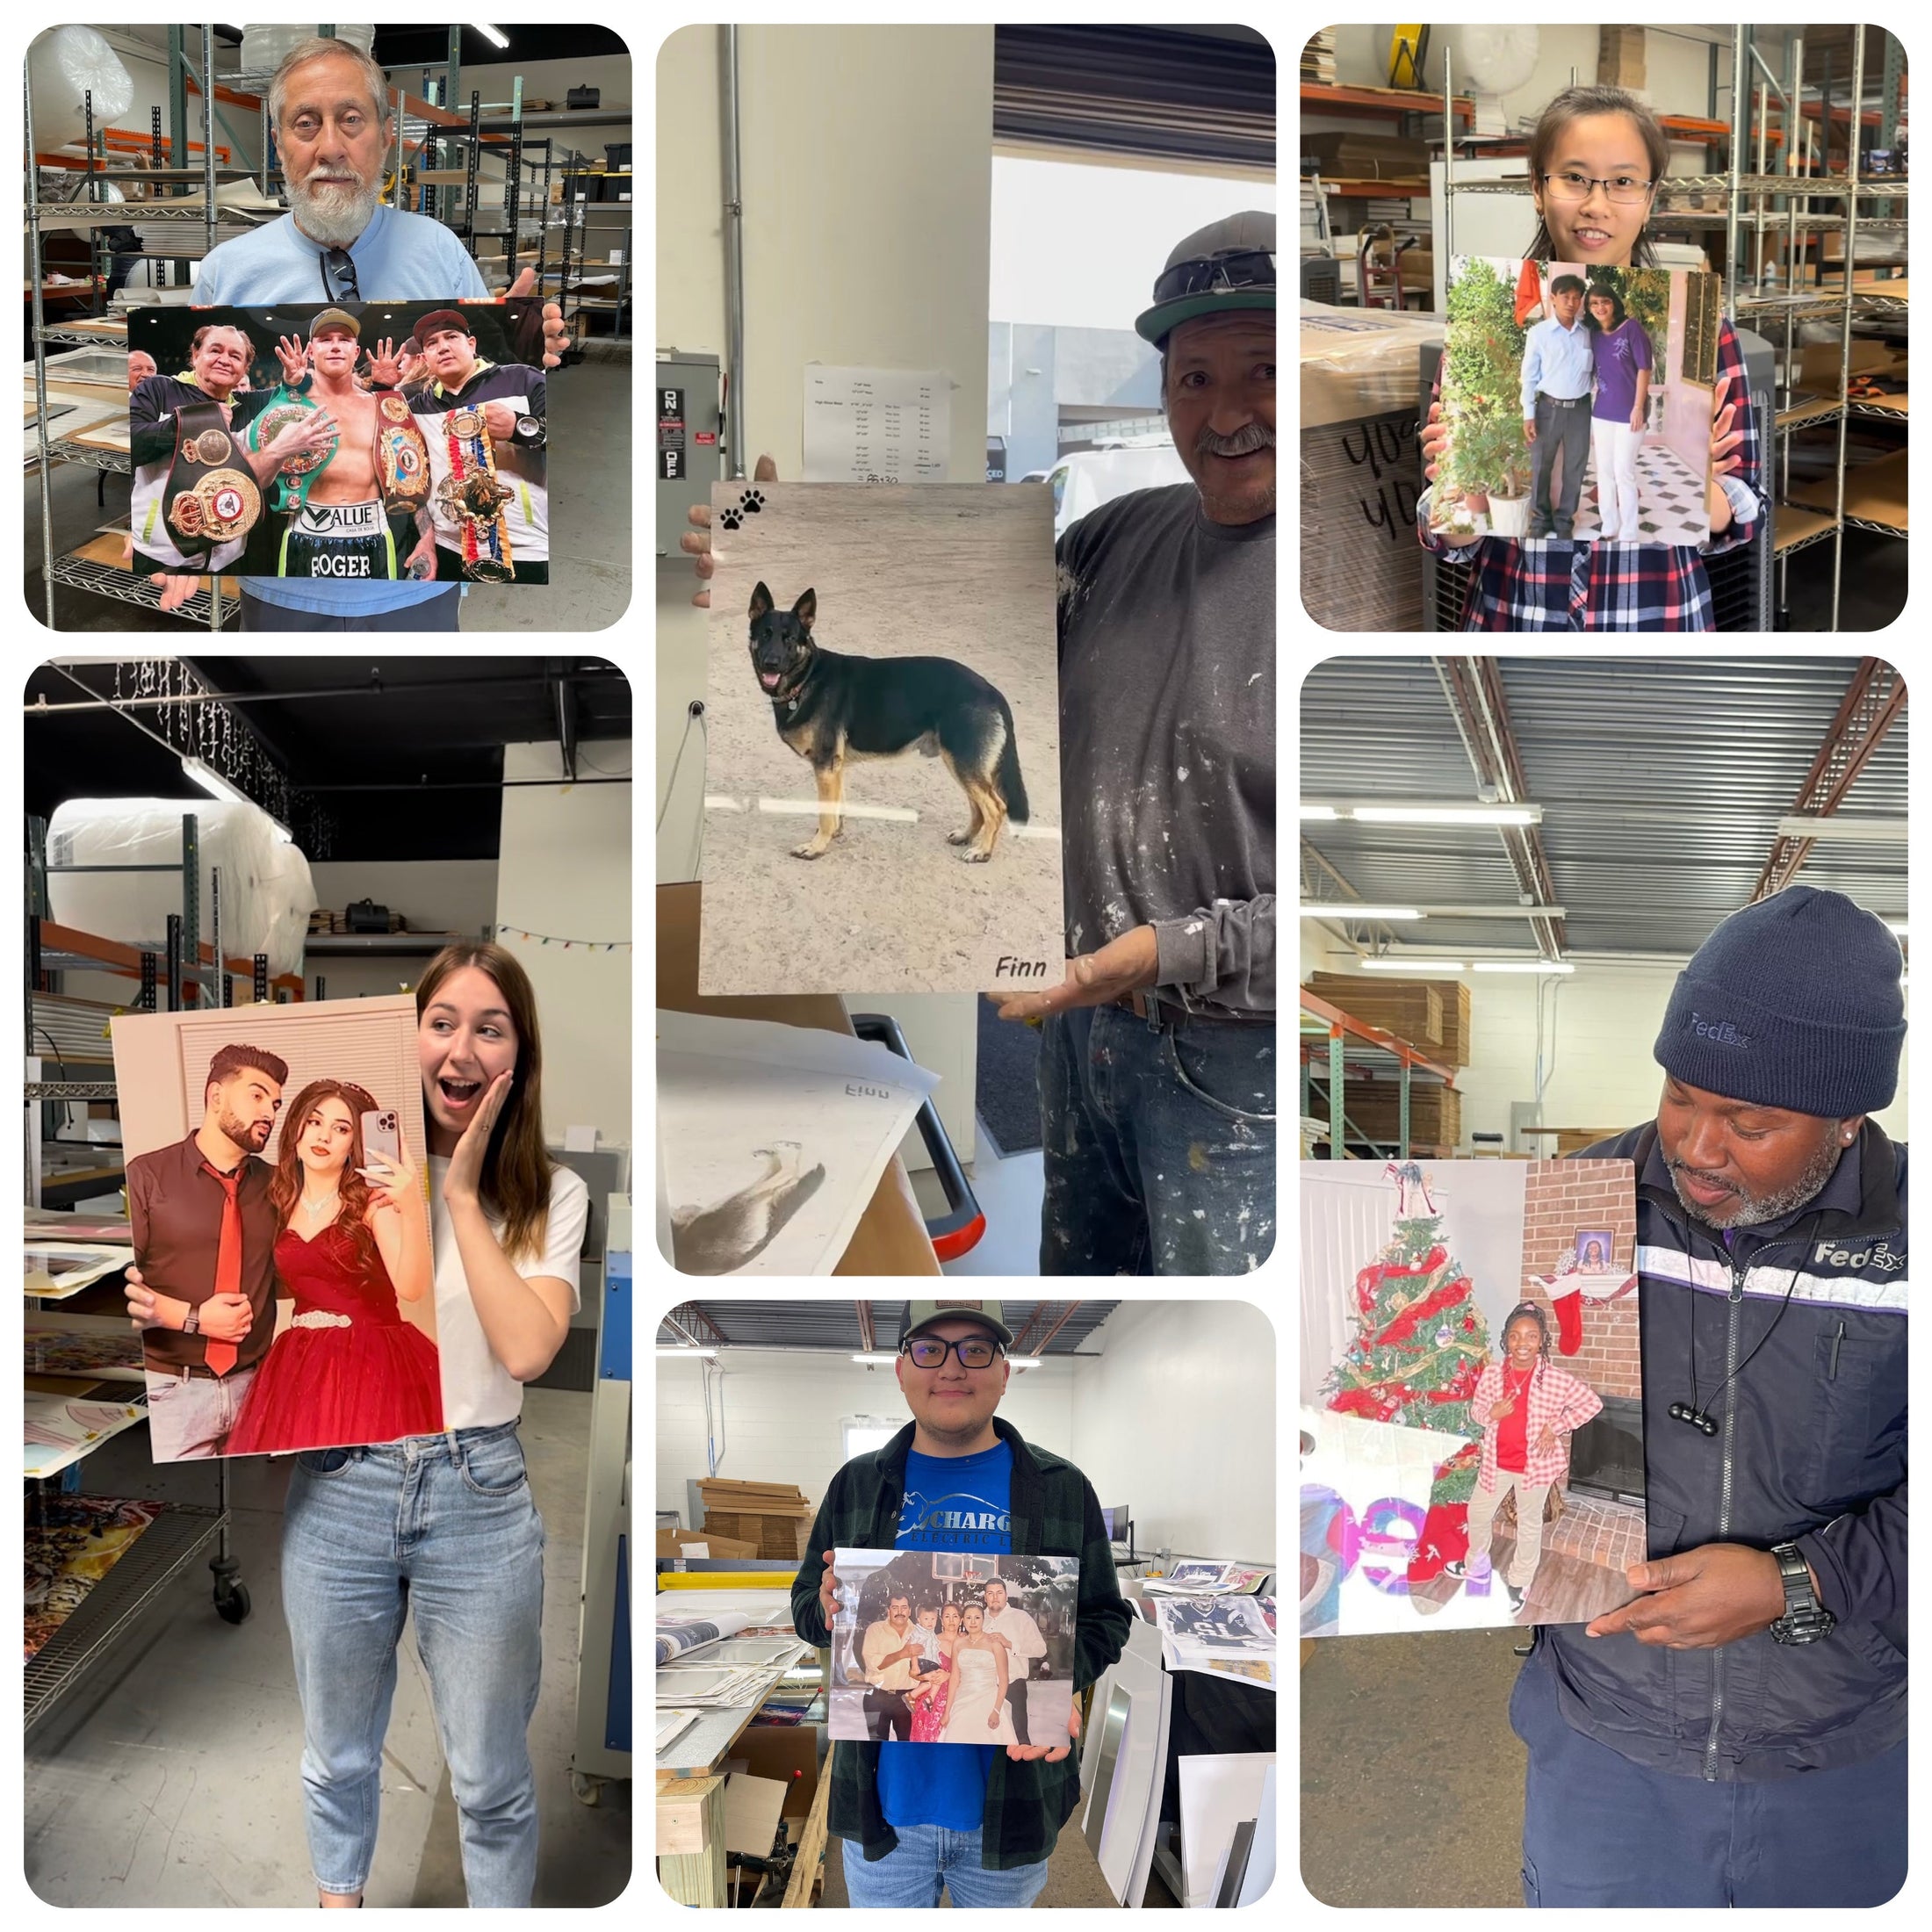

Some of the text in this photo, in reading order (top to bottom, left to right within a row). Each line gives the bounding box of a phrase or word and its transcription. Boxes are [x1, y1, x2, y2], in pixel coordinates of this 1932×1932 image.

[665, 391, 677, 409] ON
[666, 451, 677, 478] OFF
[311, 553, 371, 577] ROGER
[995, 955, 1047, 977] Finn
[1814, 1242, 1907, 1272] FedEx
[930, 1510, 1011, 1532] CHARG
[911, 1532, 991, 1544] ELECTRIC
